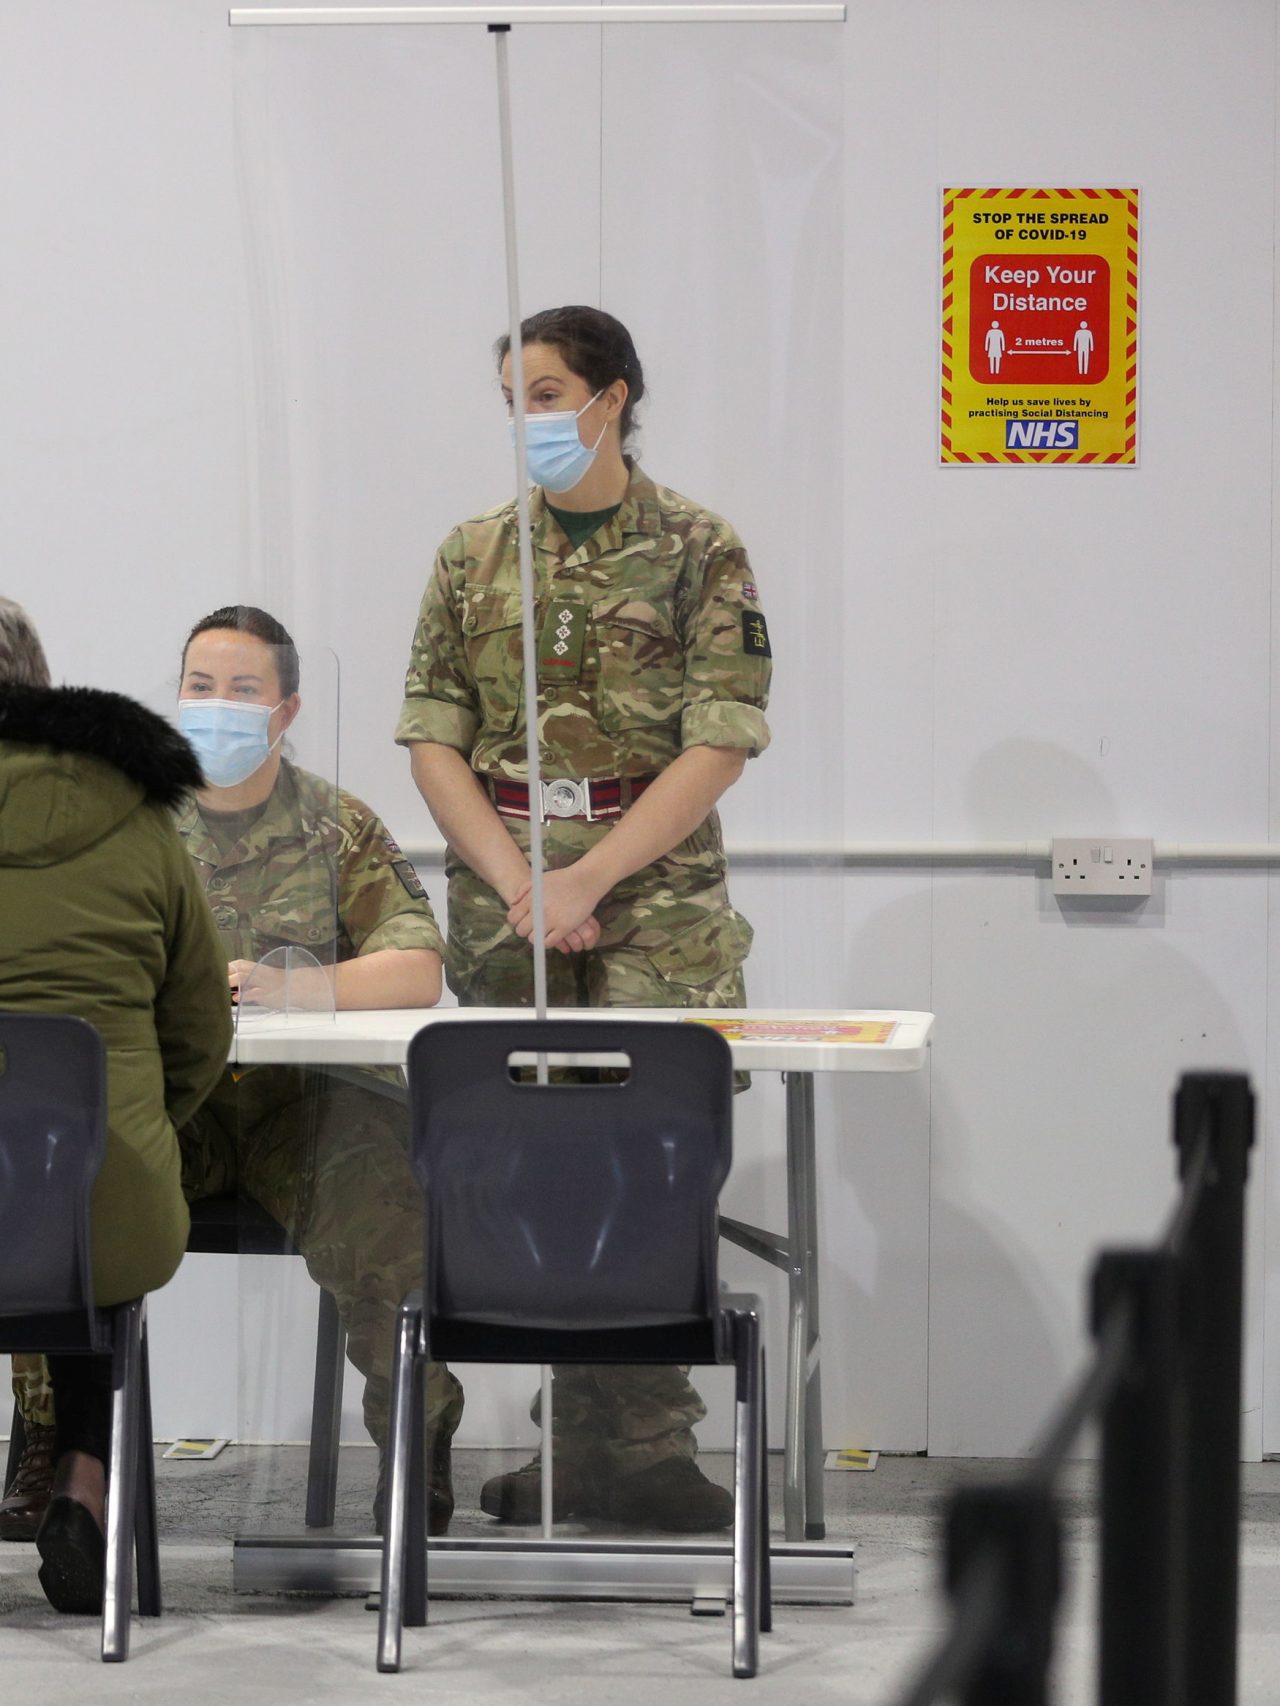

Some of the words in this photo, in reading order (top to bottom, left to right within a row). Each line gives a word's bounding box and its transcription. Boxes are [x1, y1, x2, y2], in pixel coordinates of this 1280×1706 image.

[973, 213, 1012, 224] STOP
[1016, 213, 1046, 224] THE
[1050, 213, 1109, 224] SPREAD
[994, 229, 1014, 241] OF
[1018, 229, 1087, 241] COVID-19
[985, 265, 1040, 288] Keep
[1046, 265, 1096, 284] Your
[993, 292, 1087, 311] Distance
[1015, 337, 1022, 346] 2
[1024, 338, 1064, 346] metres
[986, 397, 1010, 407] Help
[1053, 397, 1076, 406] lives
[1079, 397, 1091, 407] by
[968, 409, 1019, 419] practising
[1021, 409, 1052, 418] Social
[1055, 409, 1109, 419] Distancing
[1008, 421, 1075, 447] NHS
